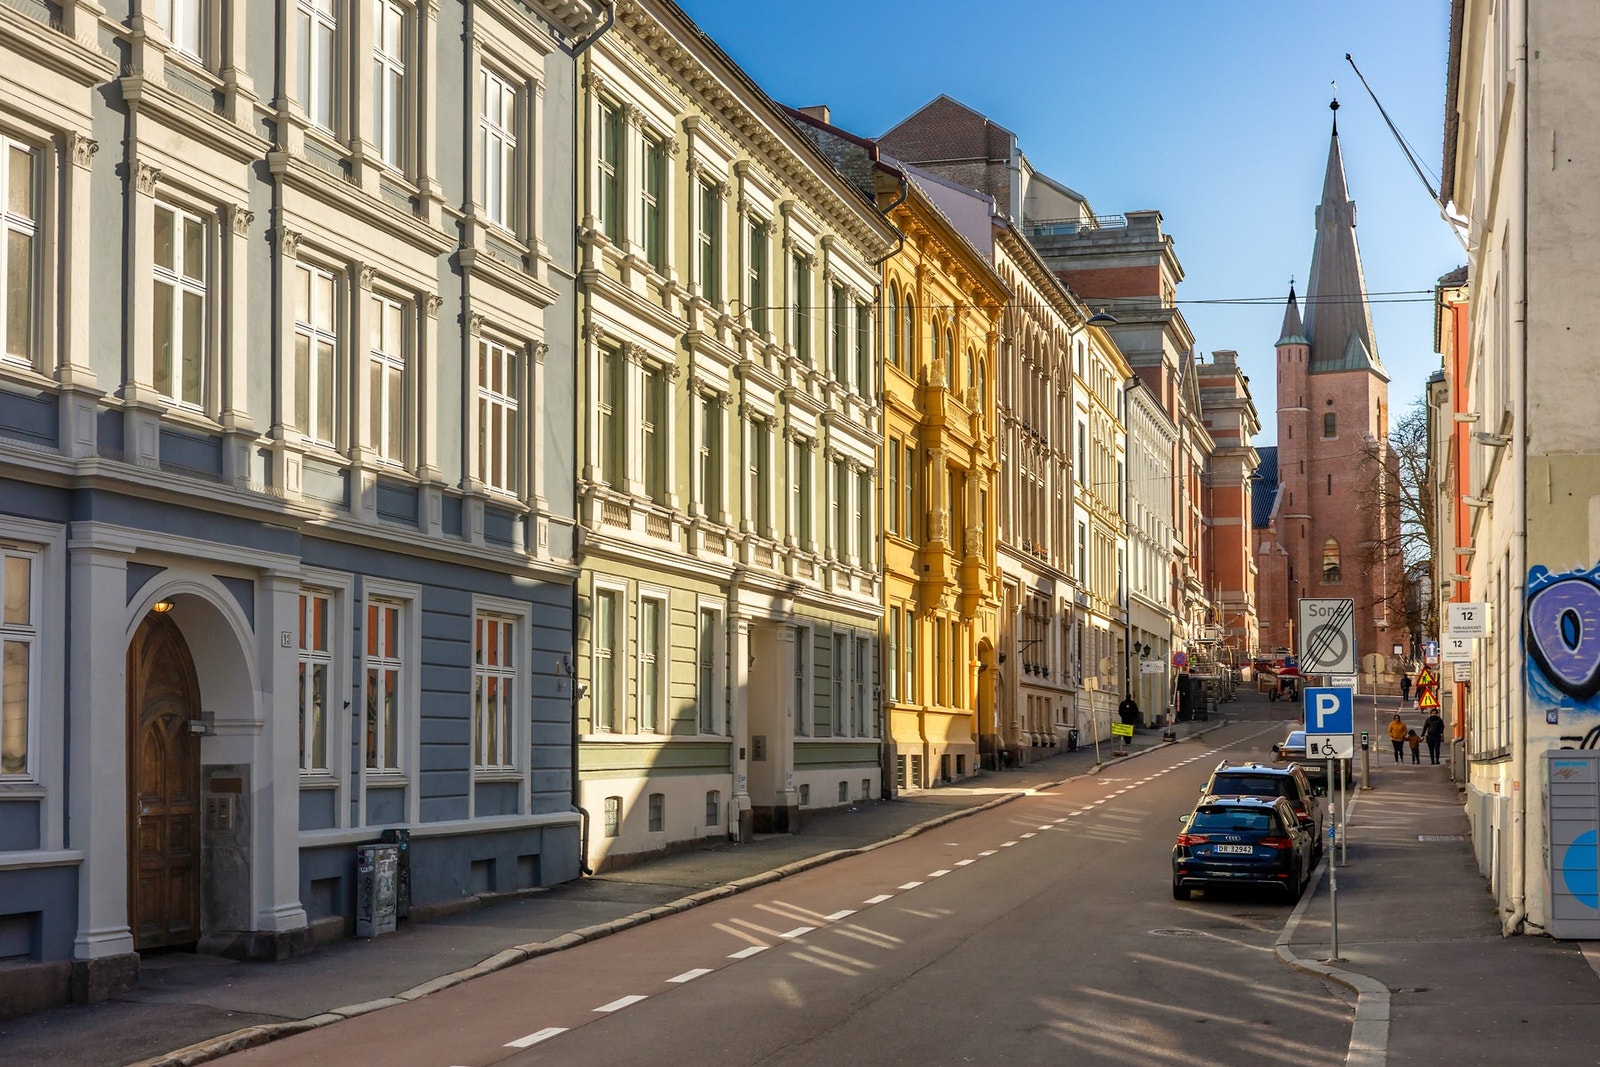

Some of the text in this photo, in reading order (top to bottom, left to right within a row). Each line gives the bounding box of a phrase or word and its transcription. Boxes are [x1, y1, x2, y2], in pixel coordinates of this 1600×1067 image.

[1461, 612, 1473, 621] 12
[1453, 640, 1463, 648] 12
[1316, 694, 1340, 729] P
